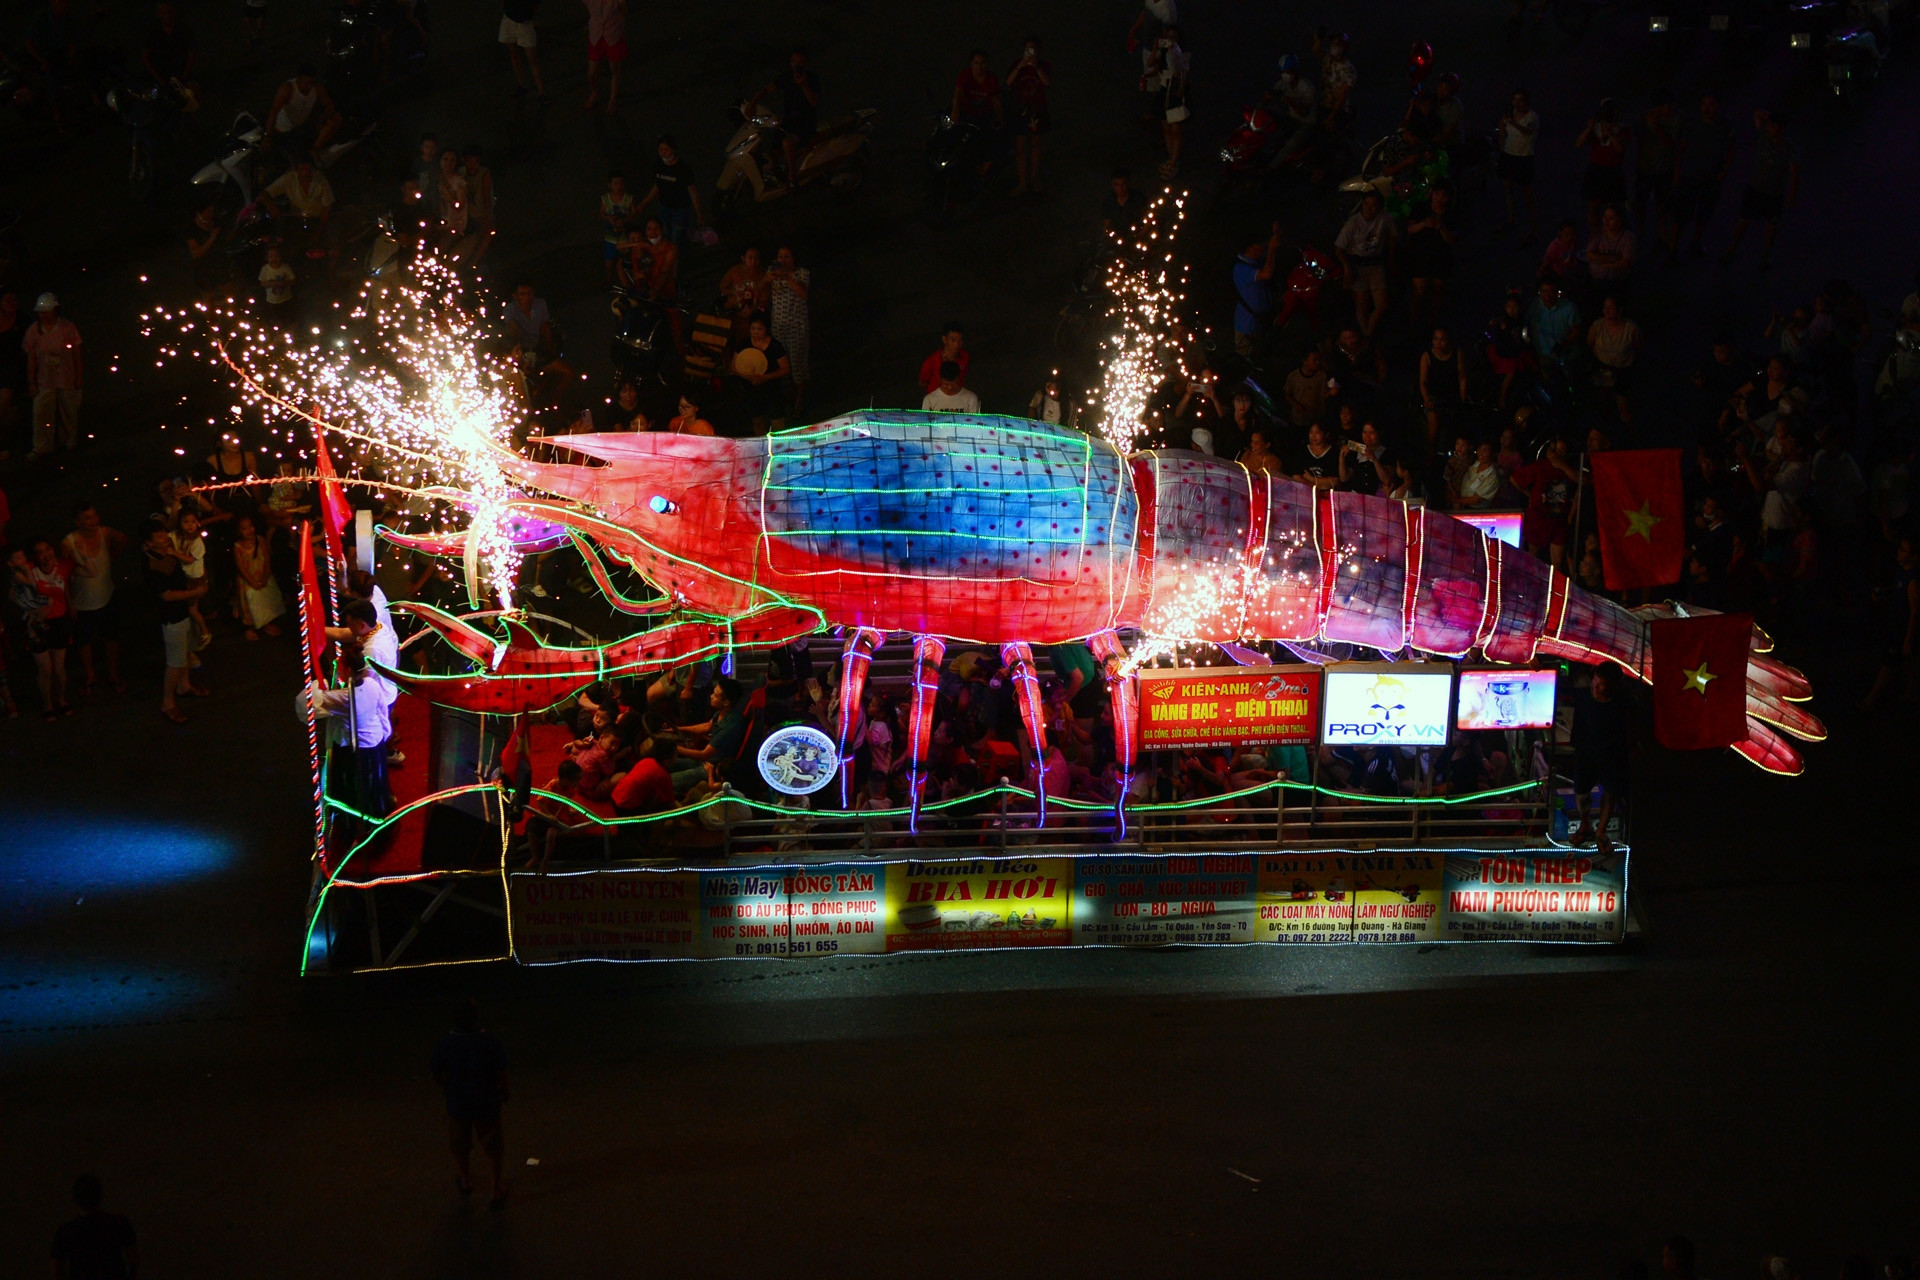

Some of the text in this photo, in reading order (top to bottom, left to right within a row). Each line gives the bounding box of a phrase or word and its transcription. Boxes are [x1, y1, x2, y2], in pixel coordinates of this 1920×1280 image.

[1151, 699, 1308, 723] VÀNG BẠC ĐIỆN THOẠI
[1144, 730, 1153, 739] GIA
[1154, 728, 1170, 738] CÔNG,
[1171, 727, 1181, 738] SỬA
[1211, 726, 1222, 737] TÁC
[1223, 725, 1236, 736] VÀNG
[1238, 726, 1250, 736] BẠC,
[1252, 726, 1261, 736] PHỤ
[1263, 725, 1275, 736] KIỆN
[1277, 725, 1289, 735] ĐIỆN
[907, 861, 984, 877] Doanh
[1480, 853, 1591, 884] TÔN THÉP
[706, 876, 739, 896] Nhà
[744, 876, 779, 899] May
[906, 875, 1058, 902] BIA HƠI
[1119, 878, 1145, 897] CHẢ
[1157, 880, 1182, 896] XÚC
[1187, 879, 1217, 896] XÍCH
[1220, 878, 1248, 898] VIỆT
[710, 898, 877, 918] MAY ĐO ÂU PHỤC, ĐỒNG PHỤC
[1113, 902, 1138, 921] LỢN
[1181, 901, 1216, 918] NGỰA
[1261, 901, 1436, 922] CÁC LOẠI MÁY NÔNG LÂM NGƯ NGHIỆP
[1449, 890, 1615, 917] NAM PHƯỢNG KM 16
[713, 925, 735, 941] HỌC
[739, 924, 769, 938] SINH,
[796, 920, 832, 935] NHÓM,
[836, 919, 852, 934] ÁO
[855, 919, 874, 934] DÀI
[1096, 924, 1109, 932] Km
[1217, 922, 1231, 930] Sơn
[1238, 922, 1247, 931] TQ
[1269, 923, 1284, 932] Đ/C:
[1286, 923, 1299, 931] Km
[1302, 923, 1310, 931] 16
[1361, 922, 1385, 931] Quang
[1392, 922, 1402, 930] Hà
[1404, 922, 1426, 931] Giang
[1462, 922, 1476, 930] Km
[1604, 922, 1613, 930] TQ
[1134, 933, 1150, 942] 578
[1152, 933, 1167, 941] 283
[1197, 933, 1213, 941] 578
[1215, 932, 1230, 941] 283
[1278, 933, 1415, 942] ĐT: 097 201 2222 0978 128 868
[736, 940, 838, 955] ĐT: 0915 561 655
